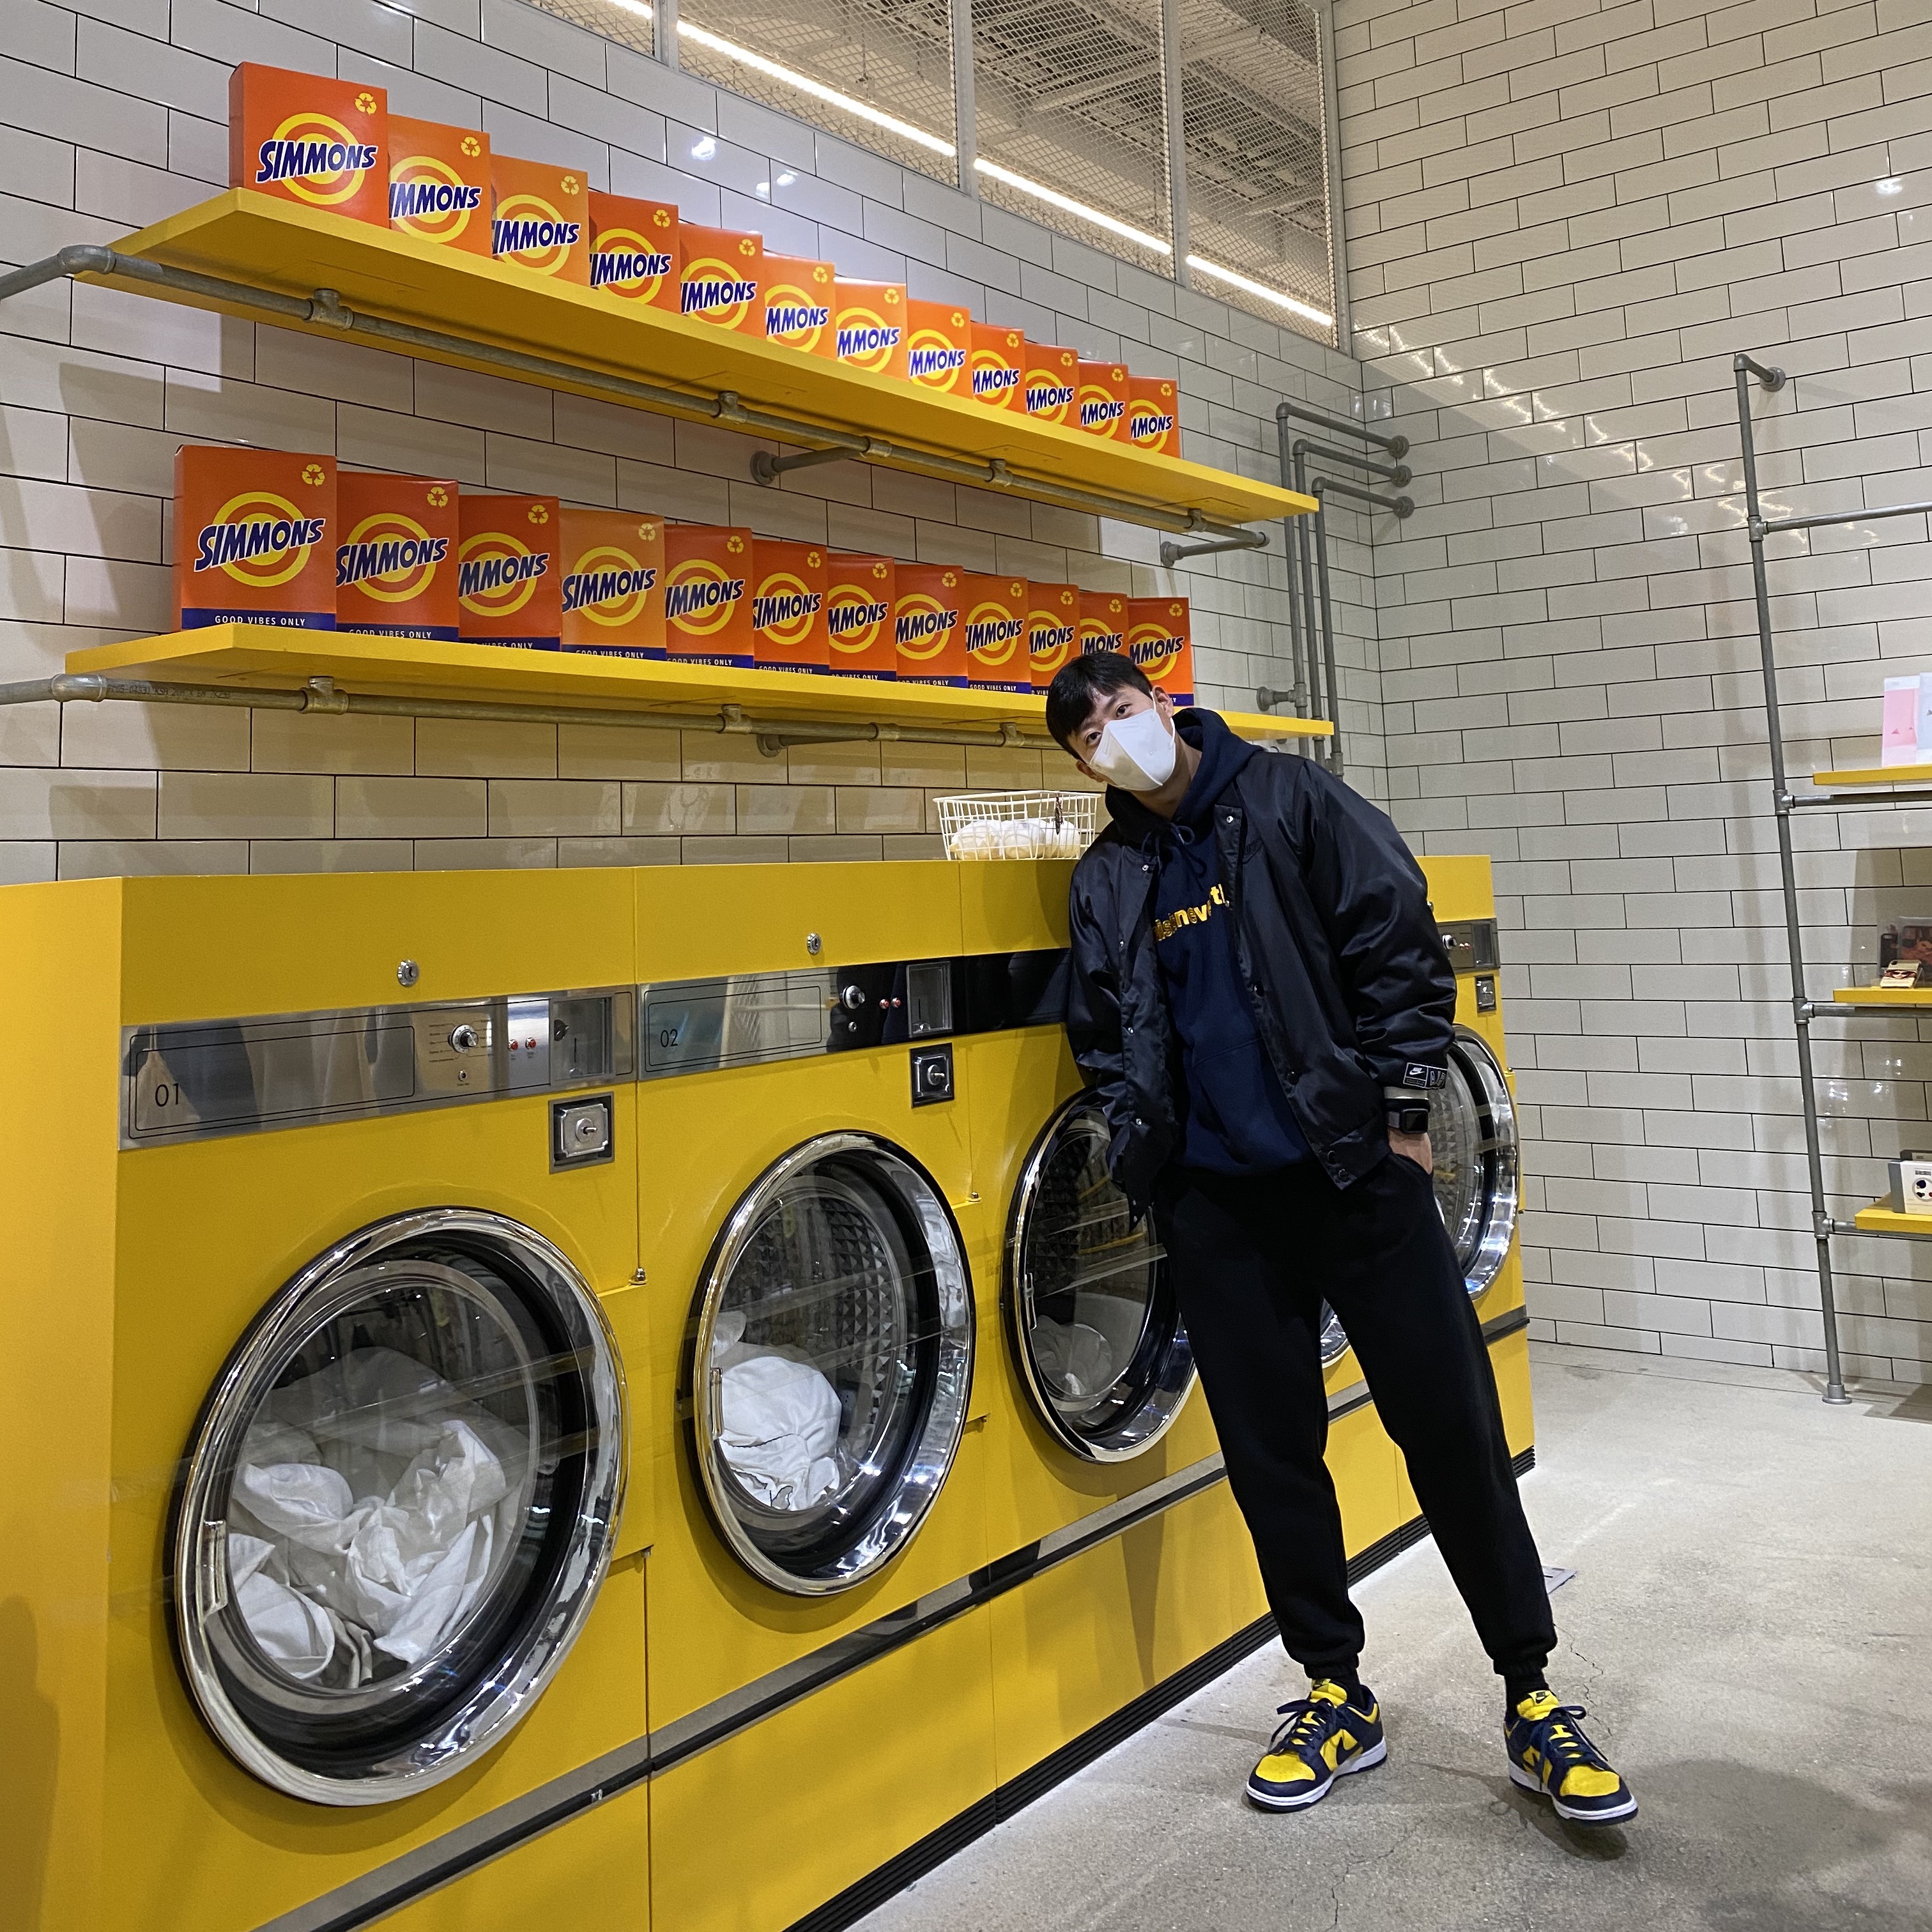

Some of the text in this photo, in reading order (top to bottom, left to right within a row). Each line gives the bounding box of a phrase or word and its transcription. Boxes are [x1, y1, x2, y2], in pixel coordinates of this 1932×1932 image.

[257, 140, 378, 183] SIMMONS
[492, 220, 580, 255] IMMONS
[589, 253, 671, 288] IMMONS
[681, 281, 756, 314] IMMONS
[909, 349, 965, 376] MMONS
[194, 519, 325, 572] SIMMONS
[336, 538, 448, 586] SIMMONS
[459, 553, 549, 598] MMONS
[562, 568, 657, 613] SIMMONS
[215, 615, 305, 626] GOOD VIBES ONLY
[967, 619, 1023, 653] IMMONS
[660, 1028, 678, 1048] 02
[155, 1082, 179, 1107] 01
